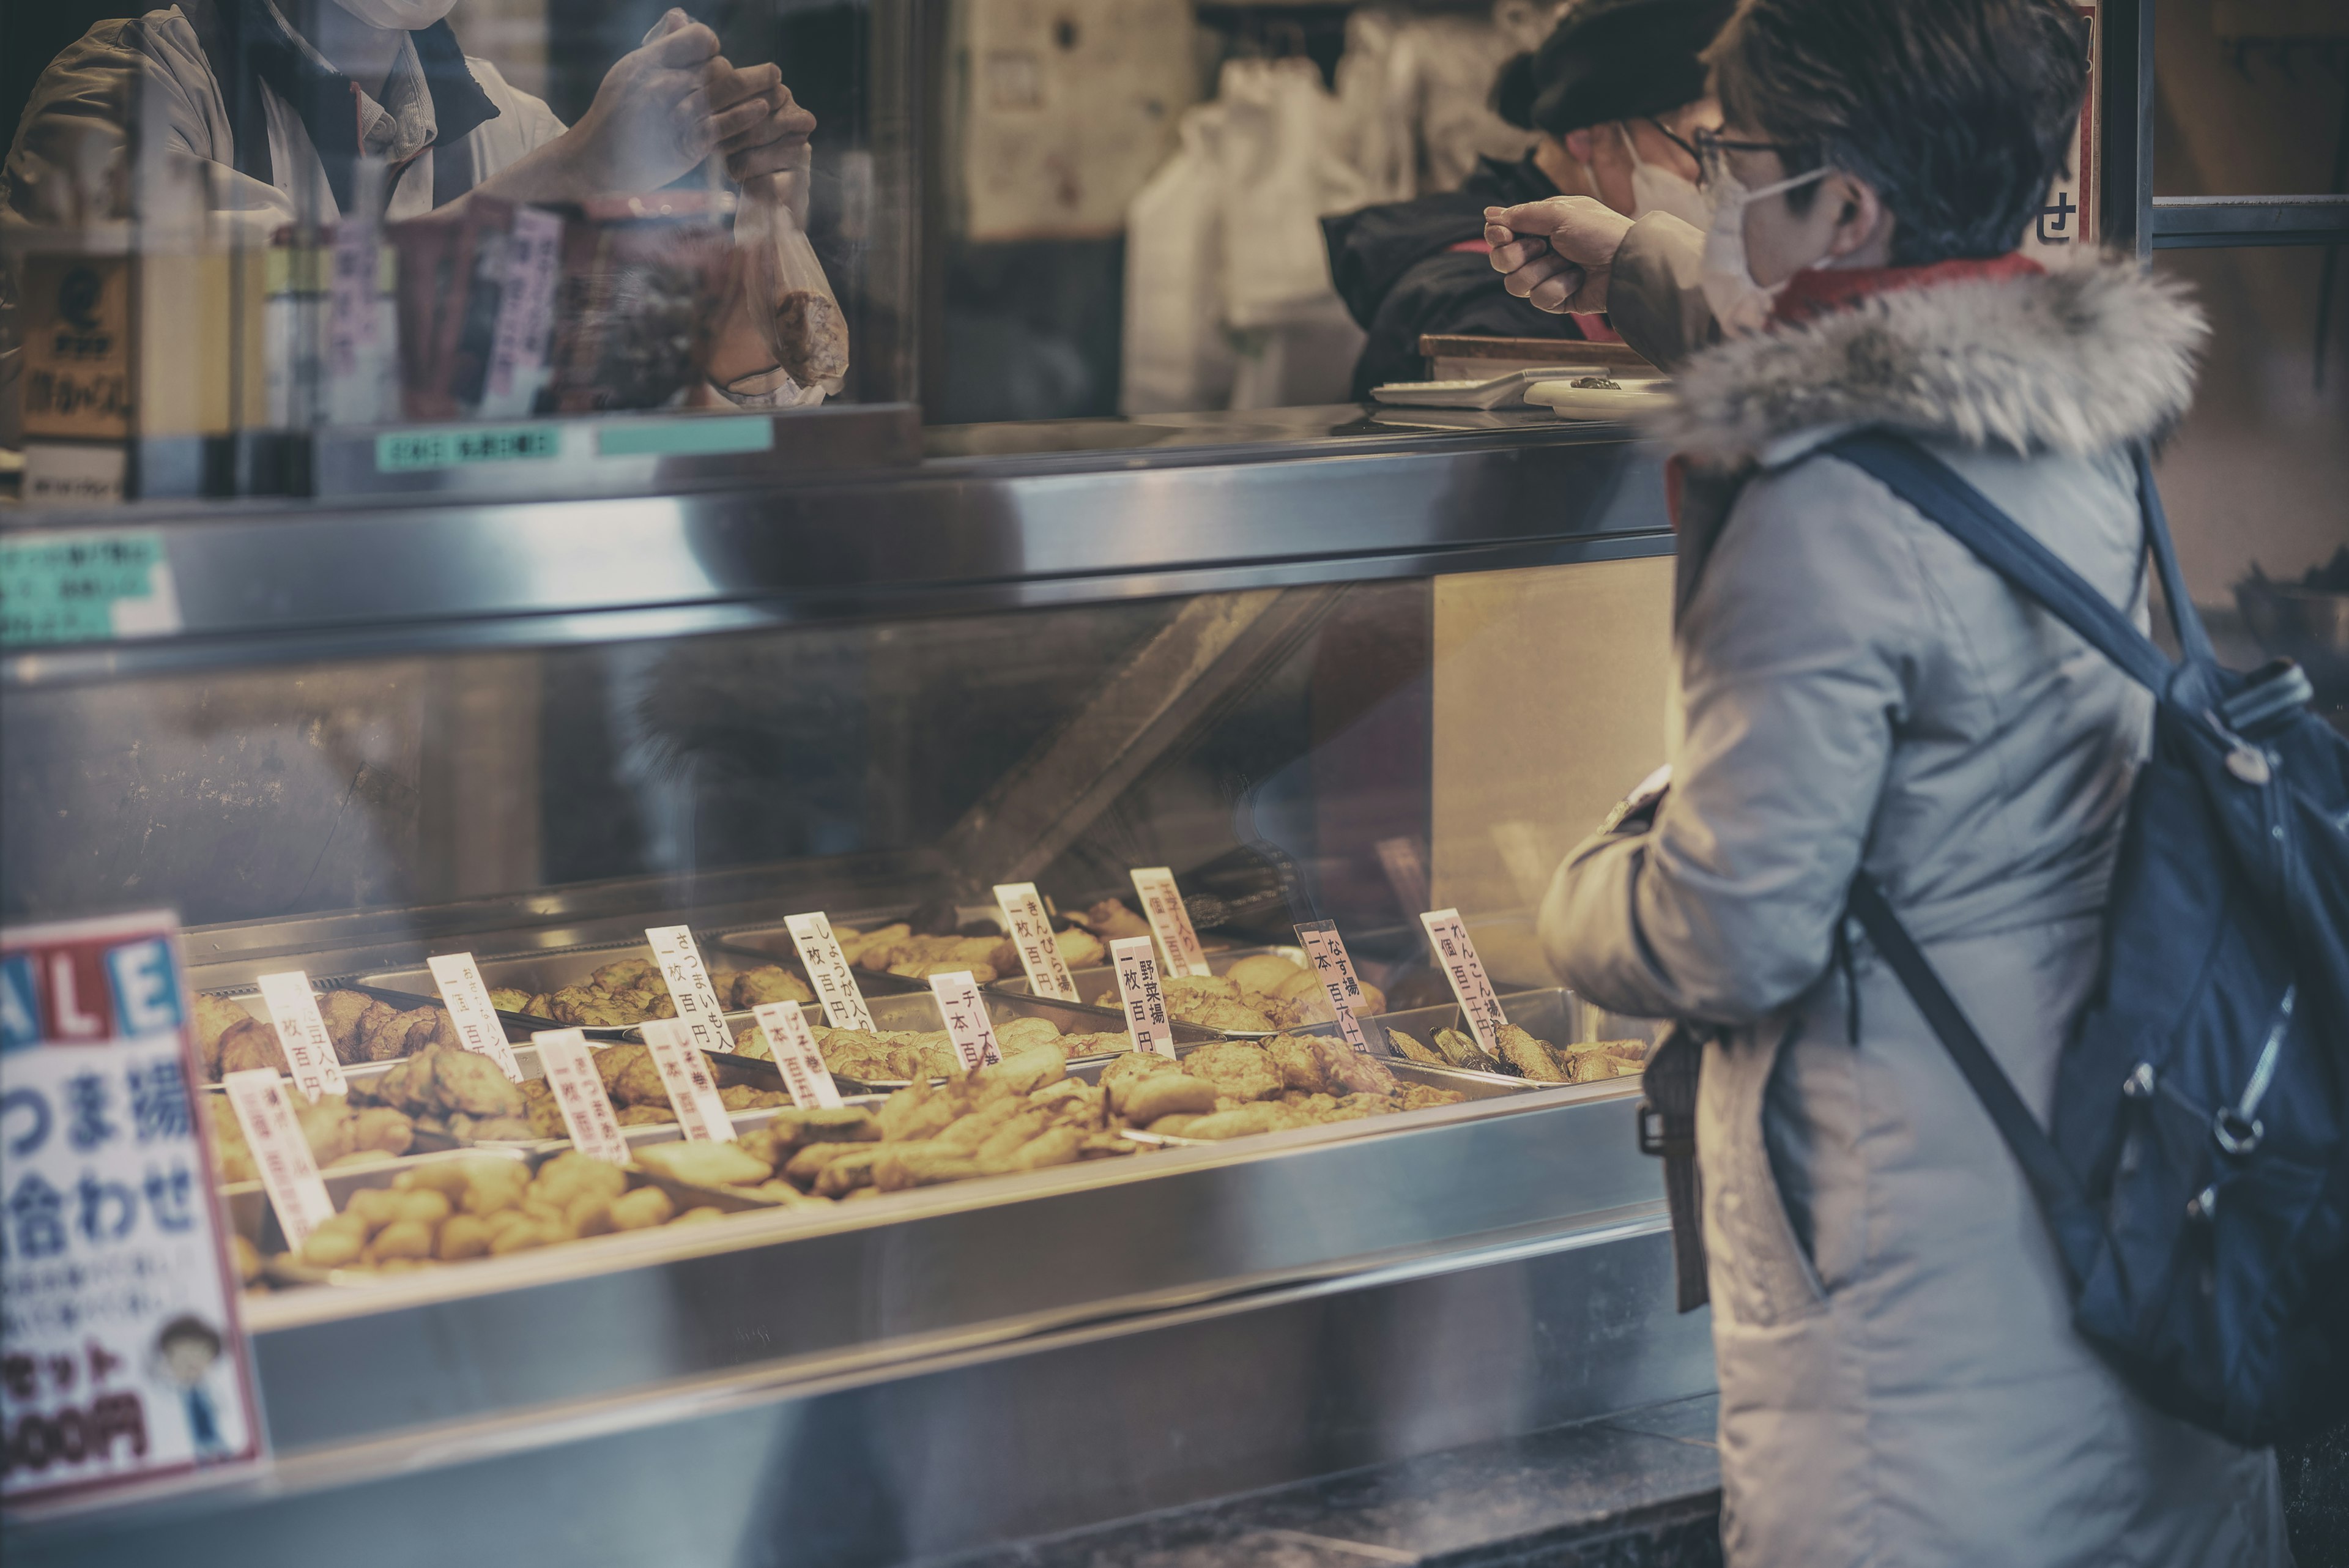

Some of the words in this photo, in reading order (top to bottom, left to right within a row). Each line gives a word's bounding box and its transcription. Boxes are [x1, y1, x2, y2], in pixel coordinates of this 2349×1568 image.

[2036, 192, 2076, 243] せ
[676, 932, 733, 1050] さつまいも入
[801, 936, 848, 1020] 一枚百円
[1011, 909, 1053, 991] 一枚百円
[1026, 901, 1072, 992] きんぴら揚
[1139, 959, 1165, 1025] 野菜揚
[1327, 938, 1360, 997] なす揚
[1434, 927, 1493, 1038] 一個百二十円
[1451, 923, 1501, 1019] れんこん揚
[661, 950, 710, 1044] 一枚百円
[946, 1000, 979, 1069] 一本百
[1121, 956, 1153, 1052] 一枚百円
[0, 1161, 196, 1260] 合わせ
